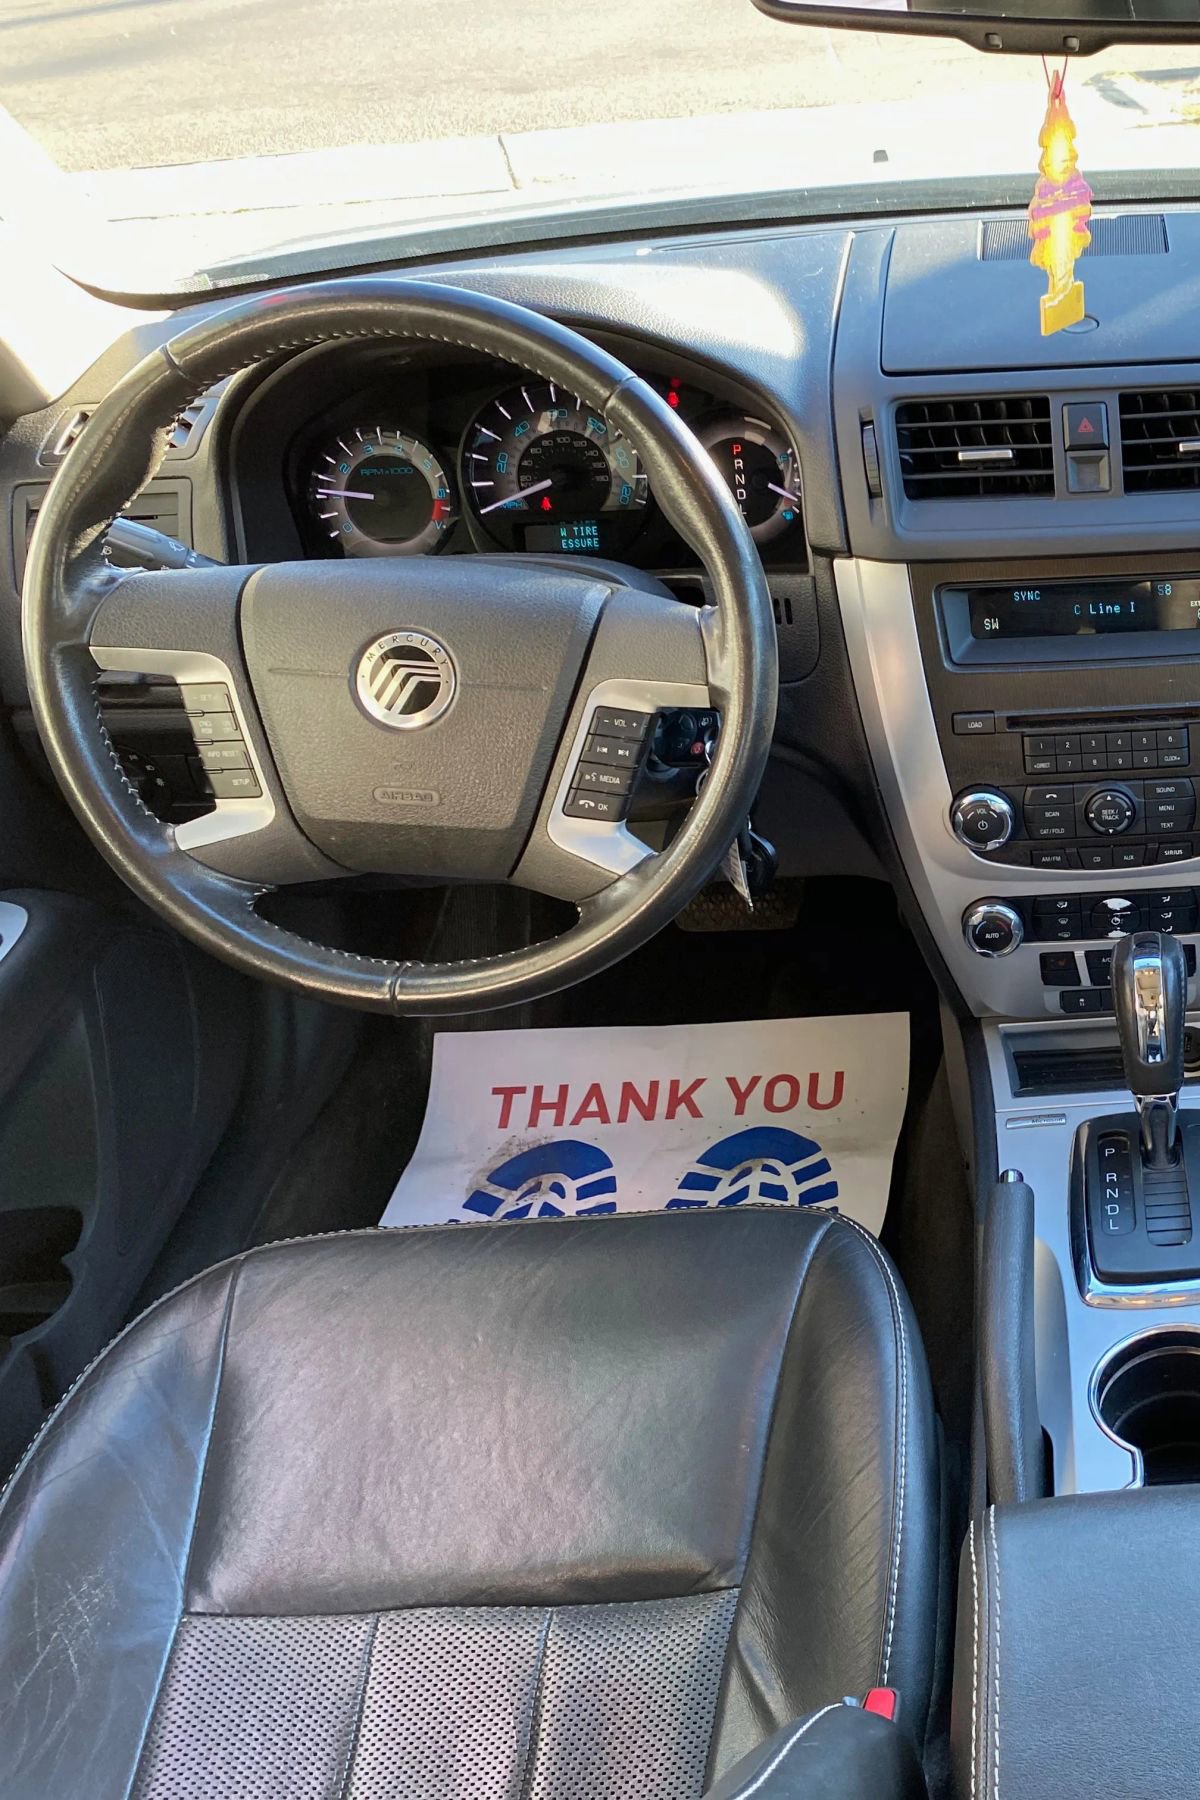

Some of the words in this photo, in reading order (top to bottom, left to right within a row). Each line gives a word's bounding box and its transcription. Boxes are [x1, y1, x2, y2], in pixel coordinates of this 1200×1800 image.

[514, 420, 530, 437] 40
[733, 444, 742, 455] P
[496, 452, 509, 474] 20
[734, 459, 744, 470] R
[339, 463, 352, 475] 2
[735, 474, 745, 485] N
[736, 488, 746, 500] D
[342, 520, 353, 533] 0
[572, 526, 598, 536] TIRE
[561, 538, 600, 549] ESSURE
[1013, 590, 1041, 601] SYNC
[1157, 584, 1172, 596] 58
[1089, 602, 1121, 614] Line
[983, 618, 1000, 630] SW
[366, 634, 449, 666] MERCURY
[614, 718, 627, 728] VOL
[600, 775, 620, 784] MEDIA
[598, 803, 608, 811] OK
[491, 1078, 708, 1129] THANK
[725, 1070, 845, 1116] YOU
[1105, 1148, 1115, 1157] P
[1106, 1172, 1117, 1182] R
[1106, 1188, 1118, 1198] N
[1107, 1204, 1119, 1215] D
[1110, 1220, 1119, 1230] L
